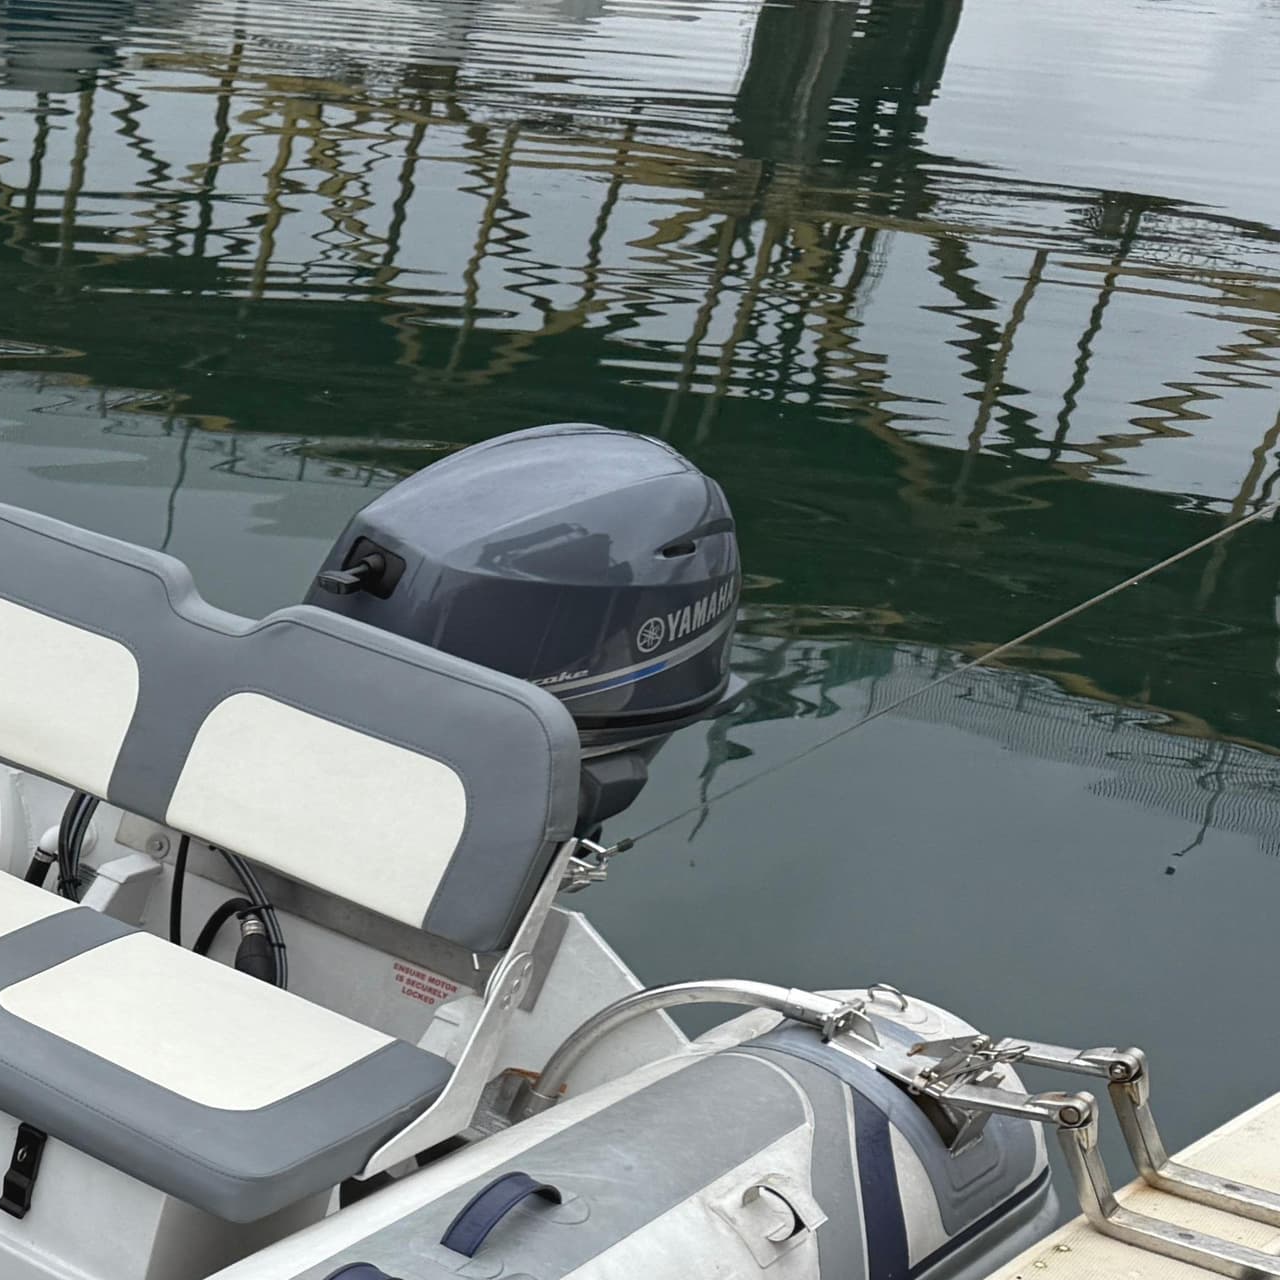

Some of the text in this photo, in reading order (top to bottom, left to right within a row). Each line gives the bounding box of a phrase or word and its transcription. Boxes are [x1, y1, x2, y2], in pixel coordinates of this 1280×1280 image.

[666, 575, 735, 642] YAMAHA
[393, 962, 458, 993] ENSURE MOTOR
[395, 973, 449, 999] IS SECURELY
[401, 985, 435, 1005] LOCKED
